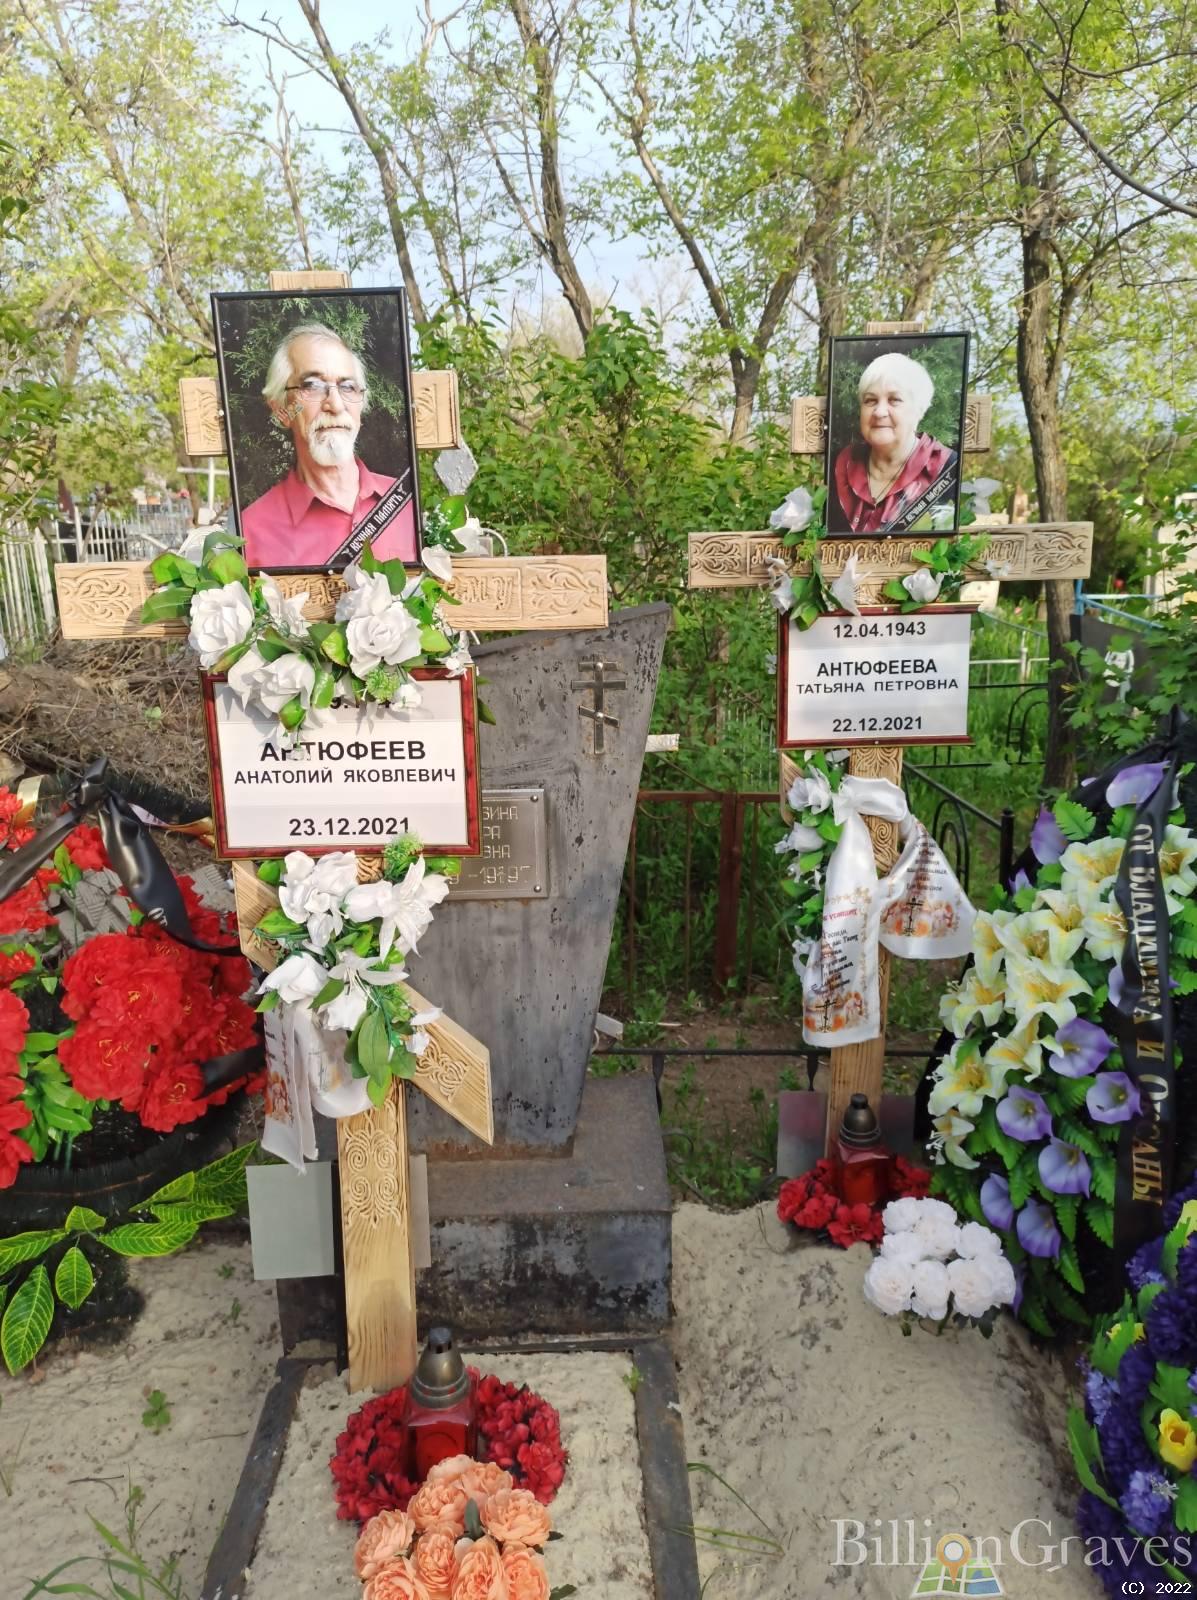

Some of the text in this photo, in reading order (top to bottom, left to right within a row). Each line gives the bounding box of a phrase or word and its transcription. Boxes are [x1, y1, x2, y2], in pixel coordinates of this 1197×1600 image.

[349, 493, 404, 552] ВЕЧНАЯ ПАМЯТЬ
[833, 621, 926, 638] 12.04.1943
[816, 659, 938, 677] АНТЮФЕЕВА
[796, 679, 959, 694] ТАТЬЯНА ПЕТРОВНА
[832, 716, 922, 732] 22.12.2021
[234, 766, 456, 785] АНАТОЛИЙ ЯКОВЛЕВИЧ
[288, 817, 411, 837] 23.12.2021
[1128, 824, 1155, 854] ОТ
[1136, 1039, 1166, 1062] И
